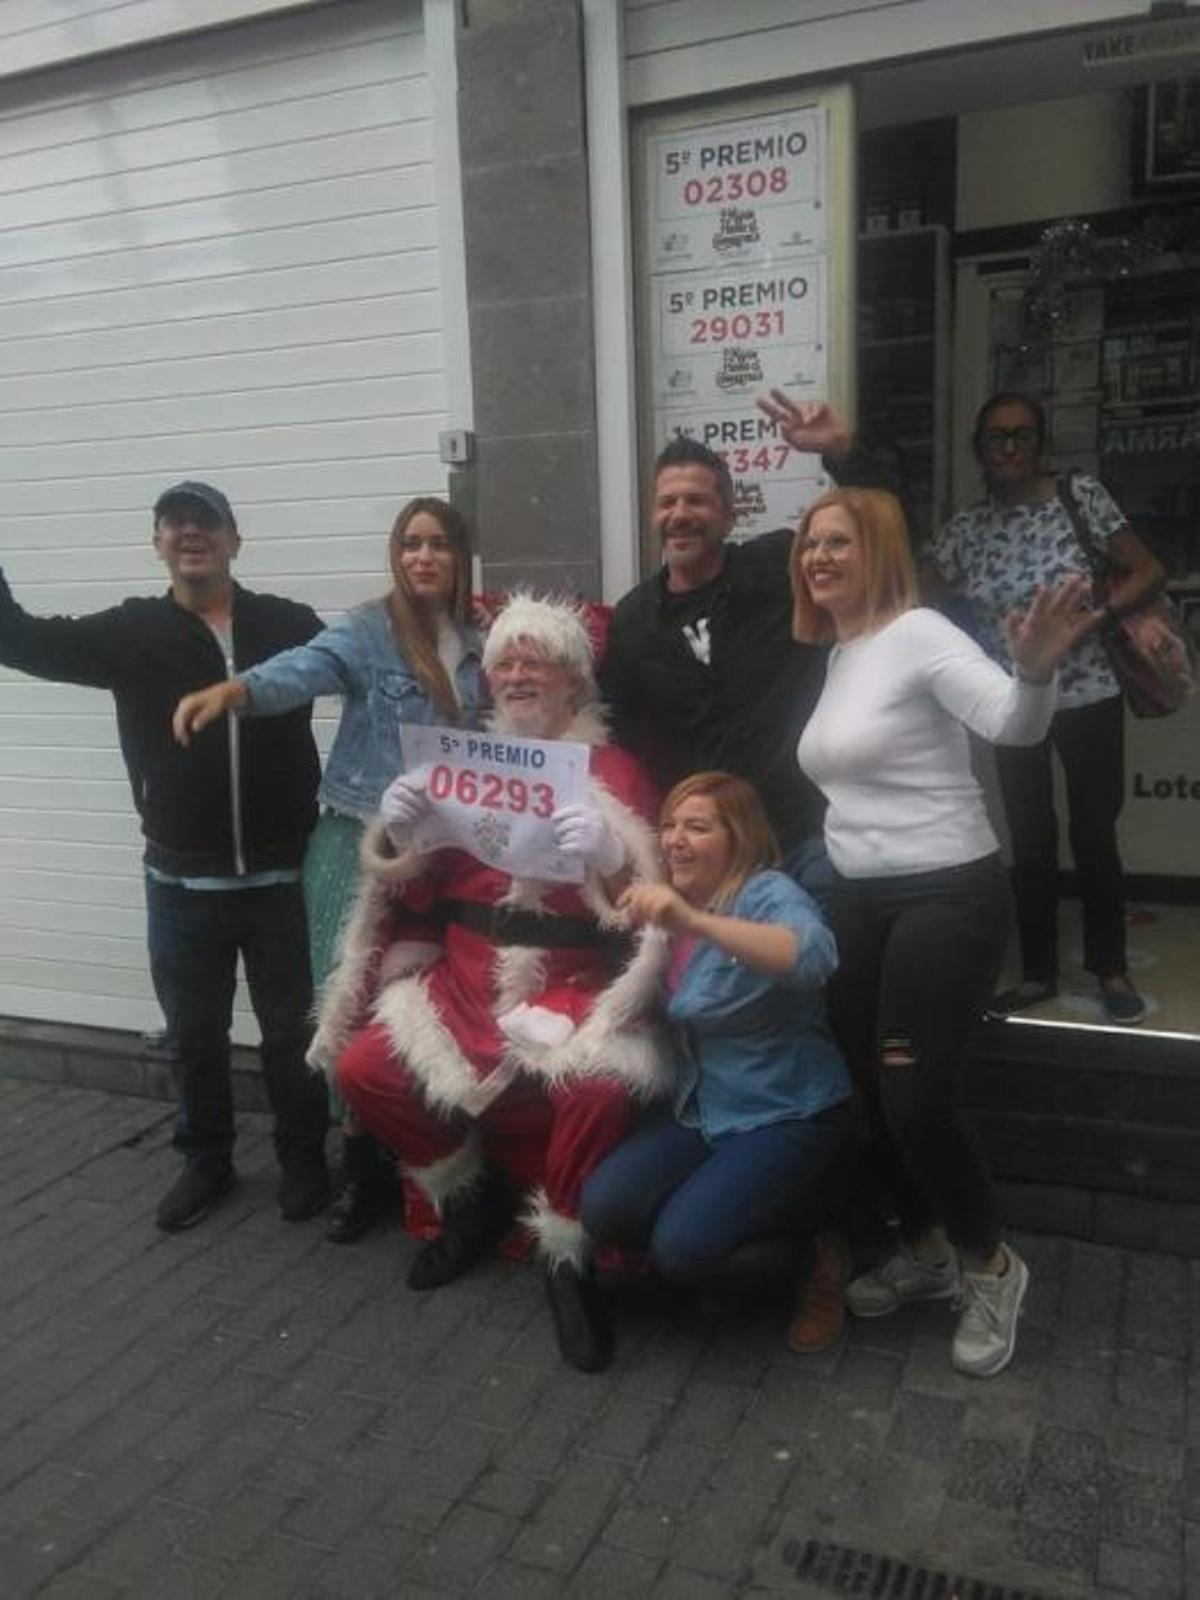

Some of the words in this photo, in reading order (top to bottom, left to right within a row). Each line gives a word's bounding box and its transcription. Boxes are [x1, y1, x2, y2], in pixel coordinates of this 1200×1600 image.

[700, 132, 807, 170] PREMIO
[684, 166, 788, 205] 02308
[703, 277, 808, 310] PREMIO
[690, 311, 785, 344] 29031
[703, 419, 778, 443] PREM
[718, 444, 790, 473] 347
[468, 739, 546, 769] PREMIO
[431, 764, 553, 818] 06293
